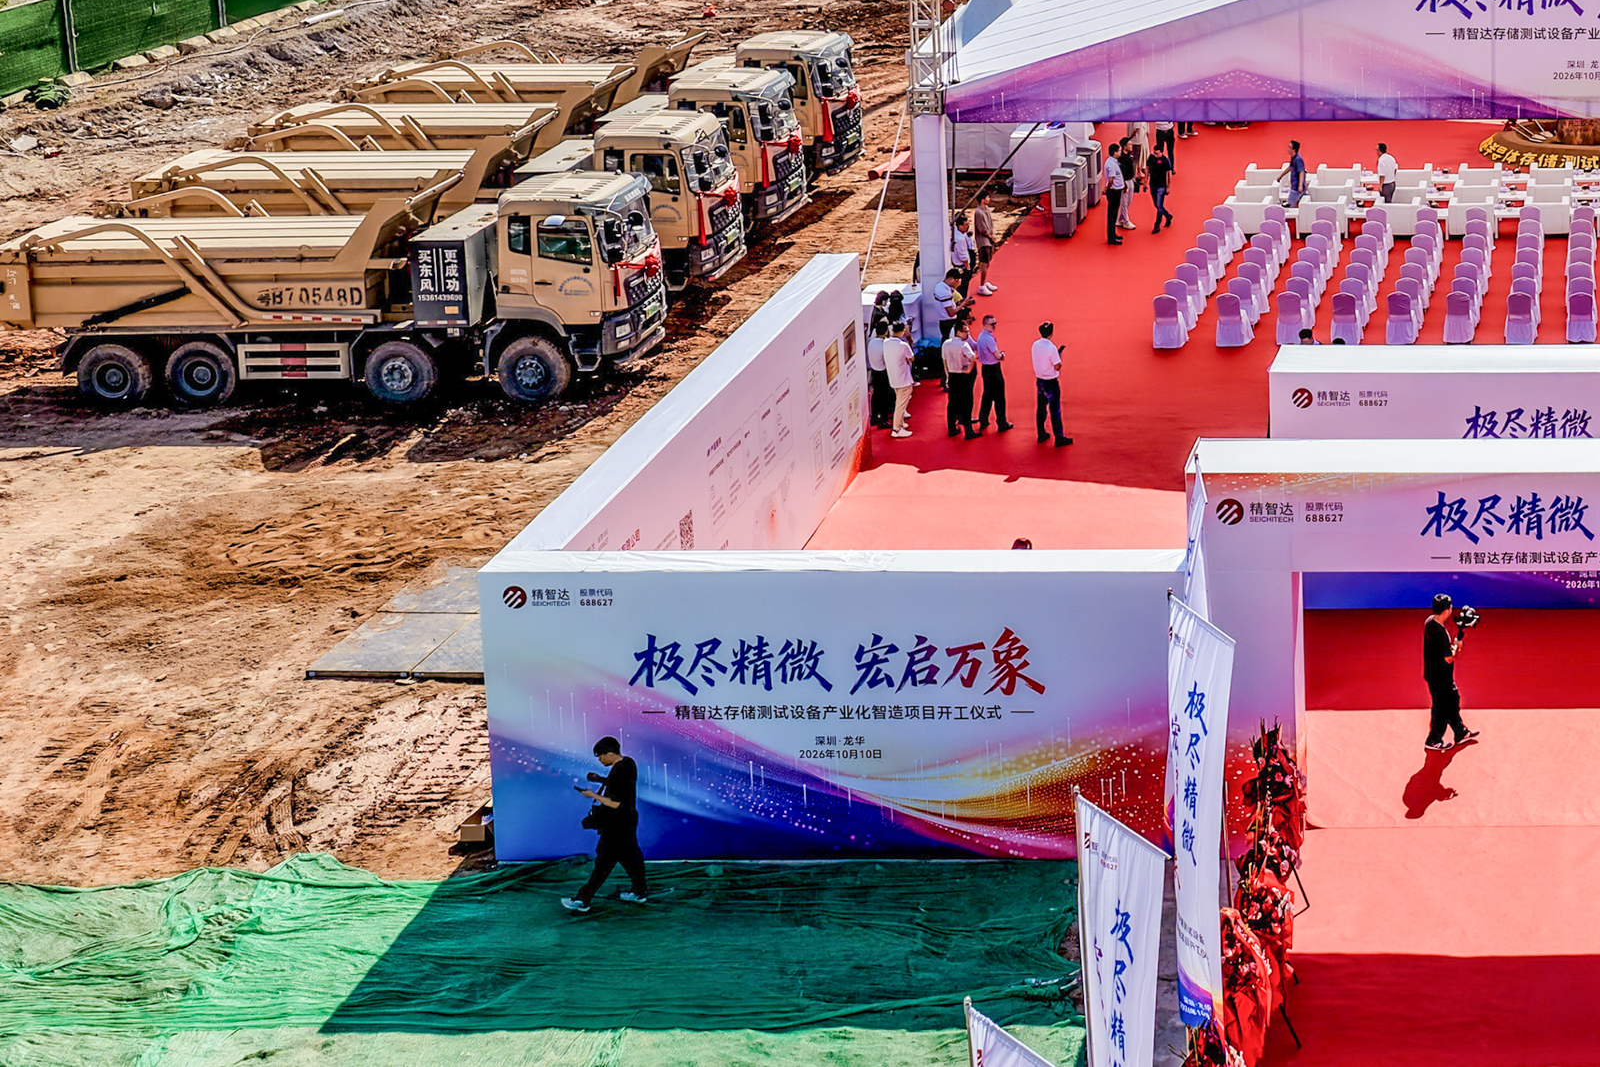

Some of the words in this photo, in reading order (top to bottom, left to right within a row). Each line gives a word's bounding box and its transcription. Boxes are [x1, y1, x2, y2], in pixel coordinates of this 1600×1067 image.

[418, 249, 434, 292] 买东风
[443, 249, 460, 292] 更成功
[257, 287, 362, 306] 粤B70548D
[1317, 390, 1350, 401] 精智达
[1359, 390, 1388, 398] 股票代码
[1359, 399, 1388, 407] 688627
[1461, 405, 1594, 438] 极尽精微
[1249, 502, 1293, 514] 精智达
[1305, 502, 1343, 511] 股票代码
[1305, 513, 1343, 522] 688627
[1420, 491, 1595, 544] 极尽精微
[532, 588, 570, 600] 精智达
[580, 589, 613, 597] 股票代码
[580, 598, 613, 607] 688627
[628, 633, 833, 696] 极尽精微
[850, 627, 1046, 696] 宏启万象
[675, 705, 1001, 720] 精智达存储测试设备产业化智造项目开工仪式
[798, 749, 882, 759] 2026年10月10日
[1182, 680, 1208, 867] 极尽精微
